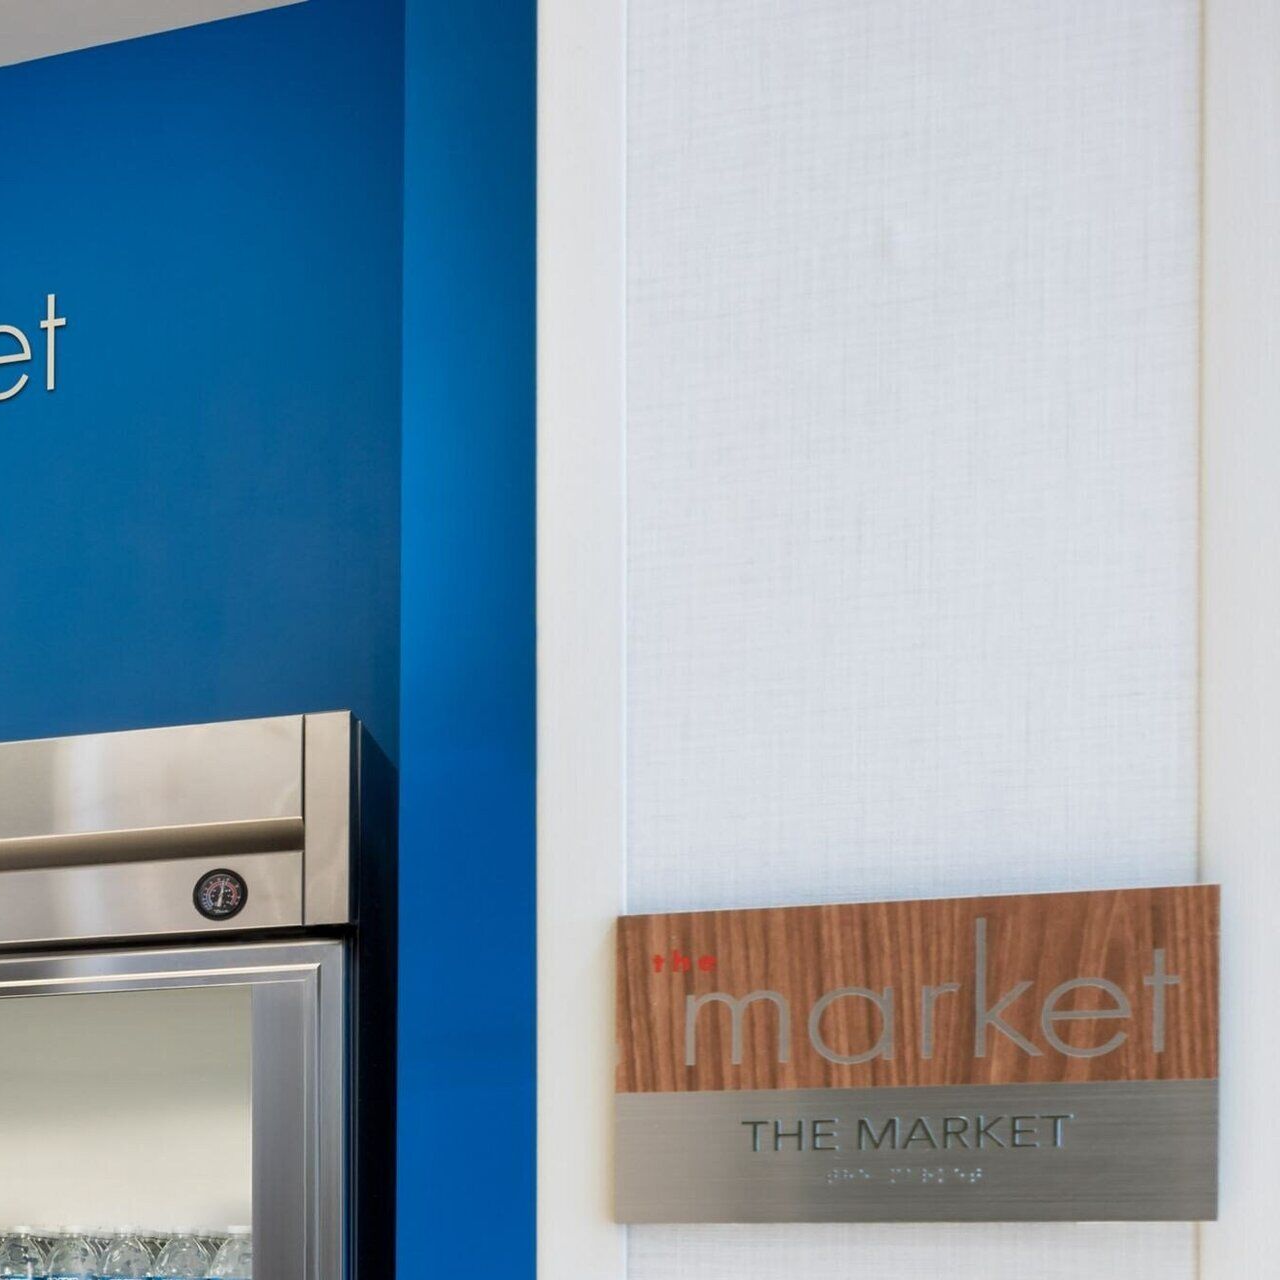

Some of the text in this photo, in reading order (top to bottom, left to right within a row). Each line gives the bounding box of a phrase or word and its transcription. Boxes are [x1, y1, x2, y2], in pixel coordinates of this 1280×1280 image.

[652, 950, 718, 973] the
[684, 917, 1182, 1067] market
[741, 1113, 1075, 1153] THE MARKET
